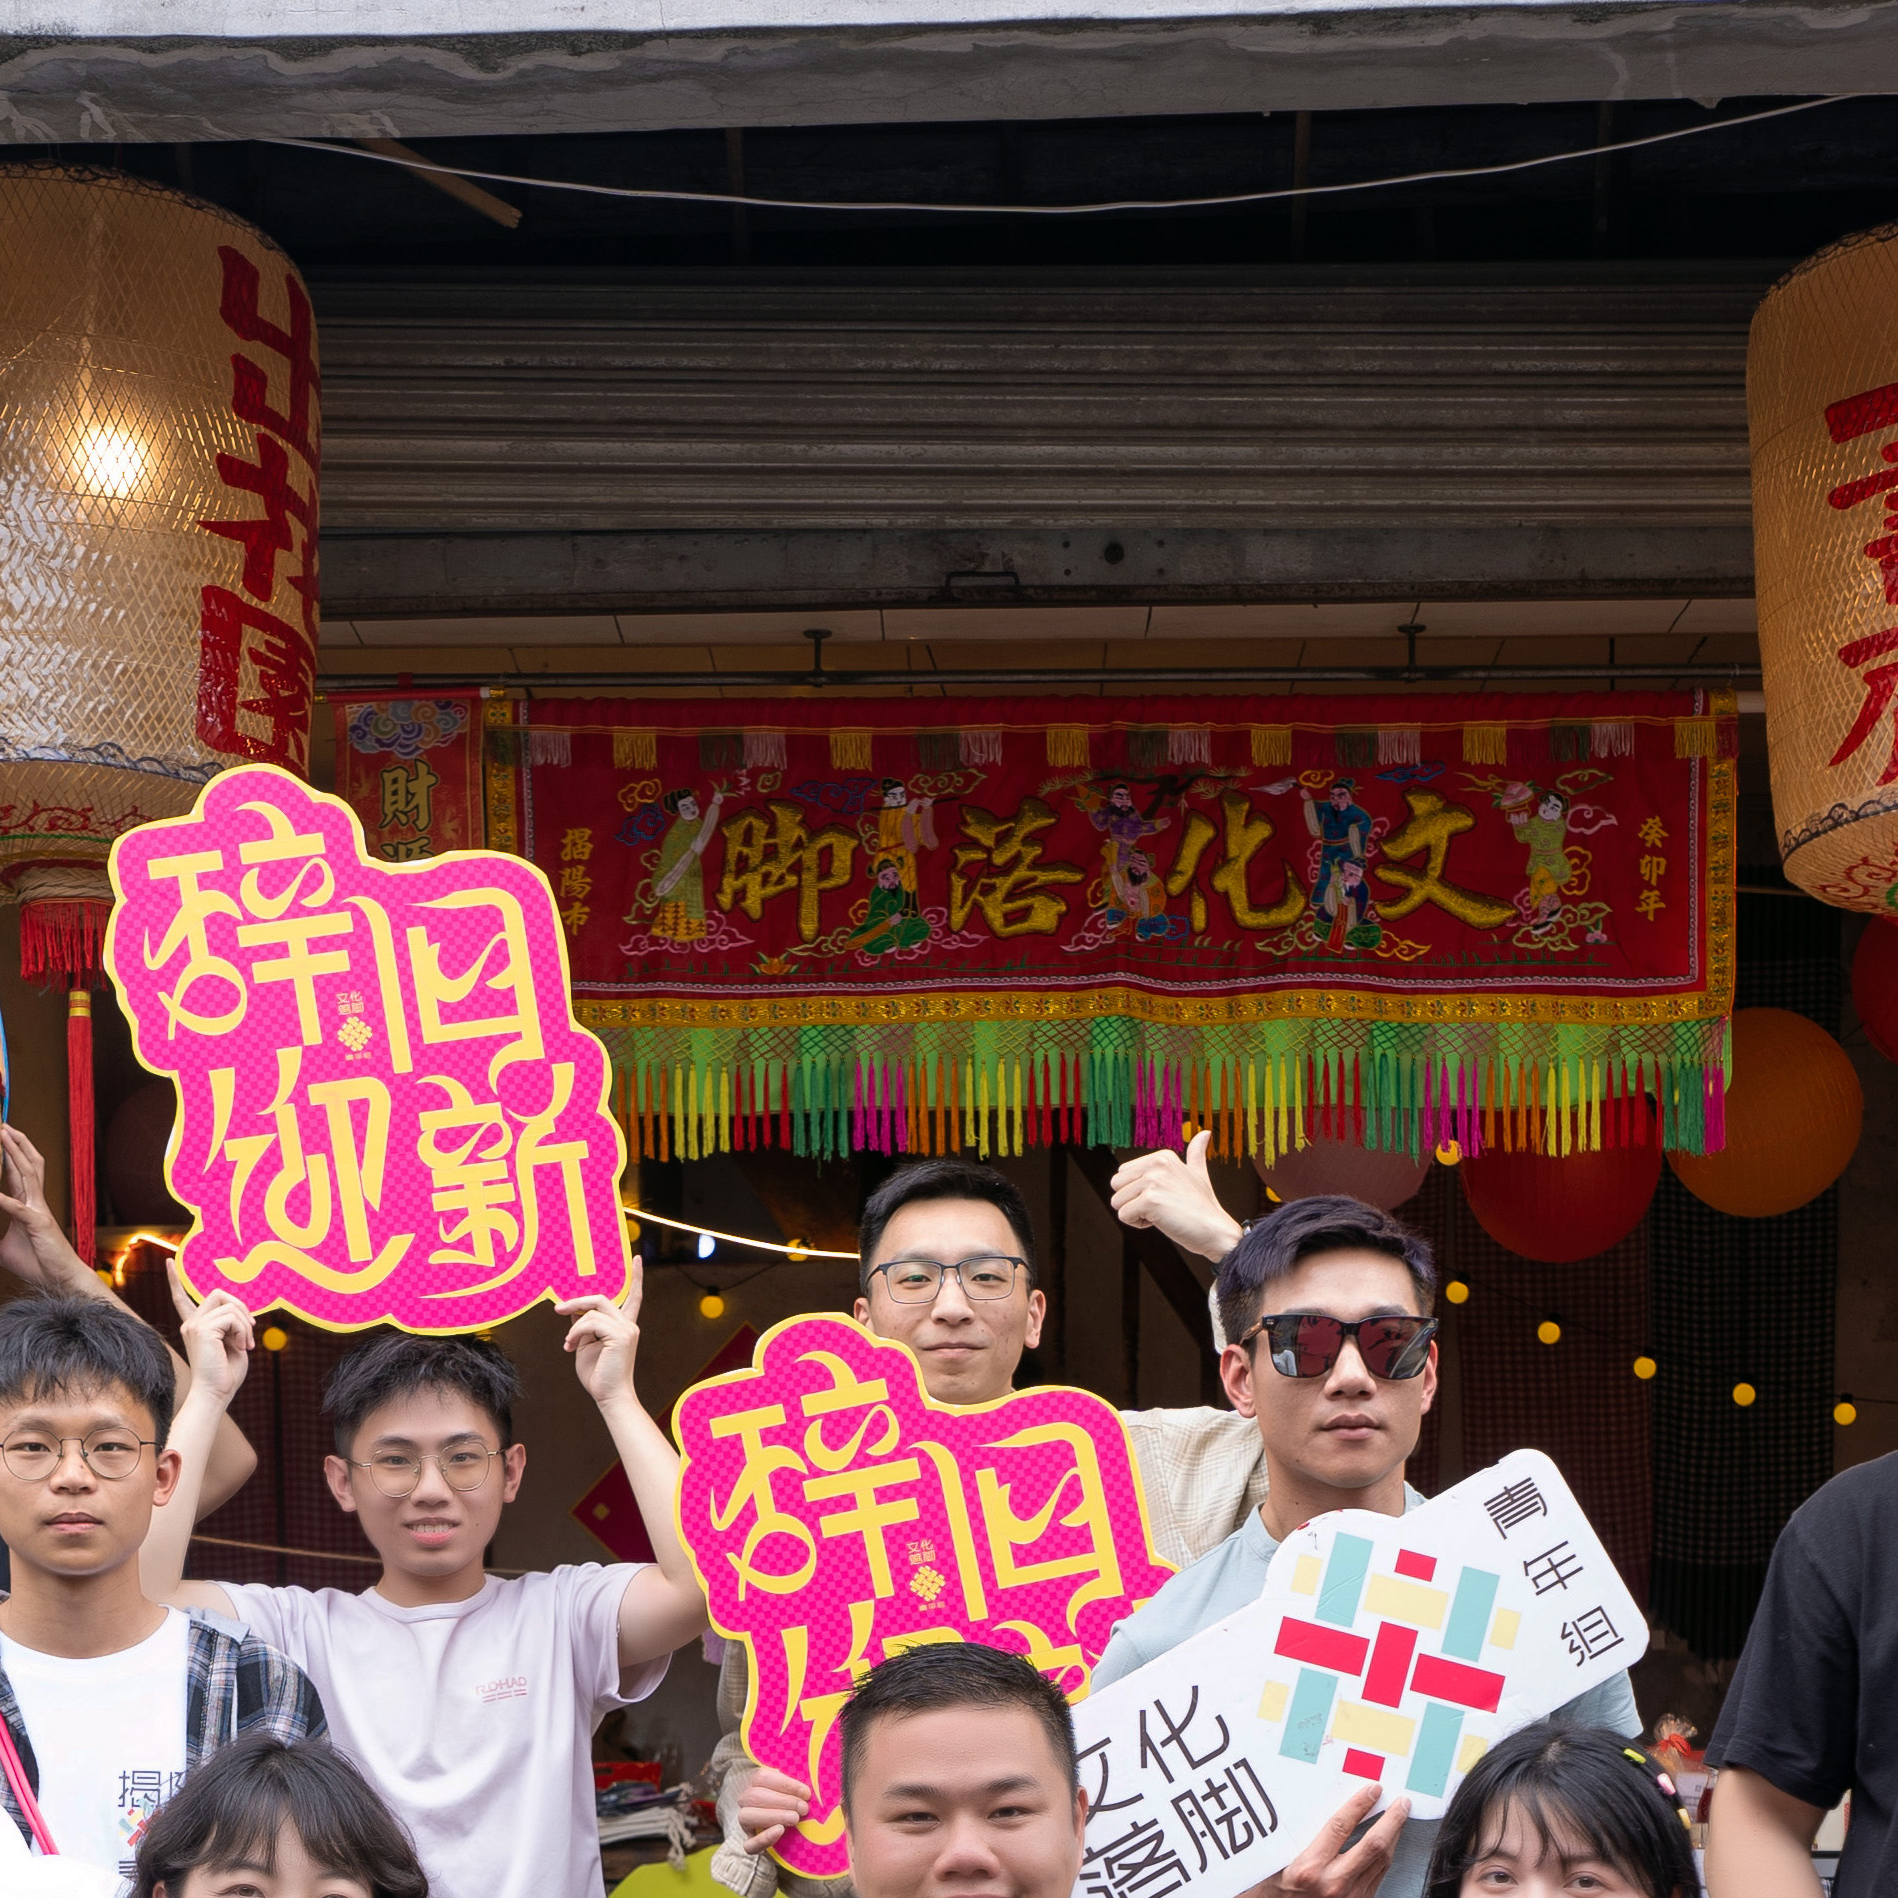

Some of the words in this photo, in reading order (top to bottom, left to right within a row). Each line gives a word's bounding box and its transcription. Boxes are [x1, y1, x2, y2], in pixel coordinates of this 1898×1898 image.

[1635, 814, 1670, 921] 癸卯年
[1484, 1476, 1625, 1668] 青年组
[1076, 1685, 1230, 1827] 文化
